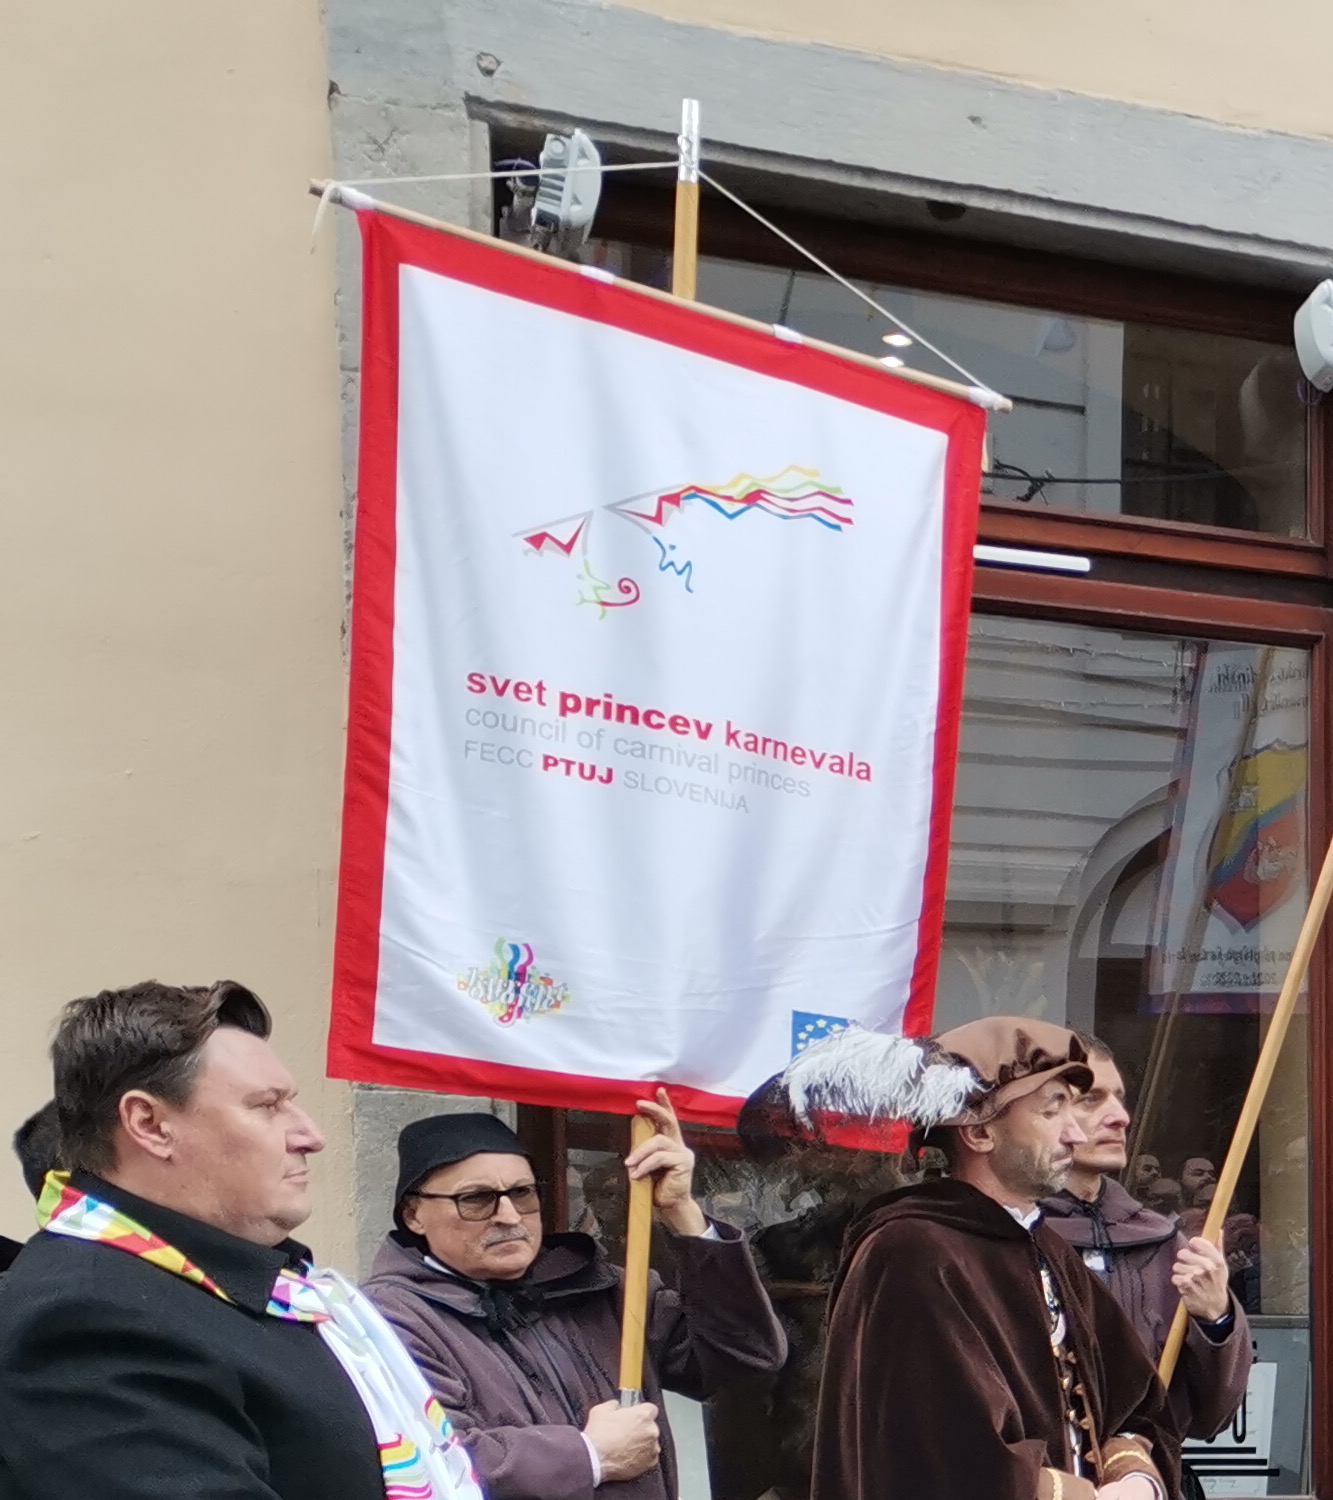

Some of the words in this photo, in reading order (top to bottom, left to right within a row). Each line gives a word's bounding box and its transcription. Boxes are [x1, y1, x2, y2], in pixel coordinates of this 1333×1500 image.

[465, 708, 567, 743] council
[577, 728, 605, 750] of
[613, 736, 719, 774] carnival
[728, 759, 811, 798] princes
[467, 672, 547, 706] svet
[558, 690, 713, 741] princev
[725, 721, 871, 781] karnevala
[464, 740, 534, 769] FECC
[542, 754, 614, 785] PTUJ
[623, 770, 749, 814] SLOVENIJA
